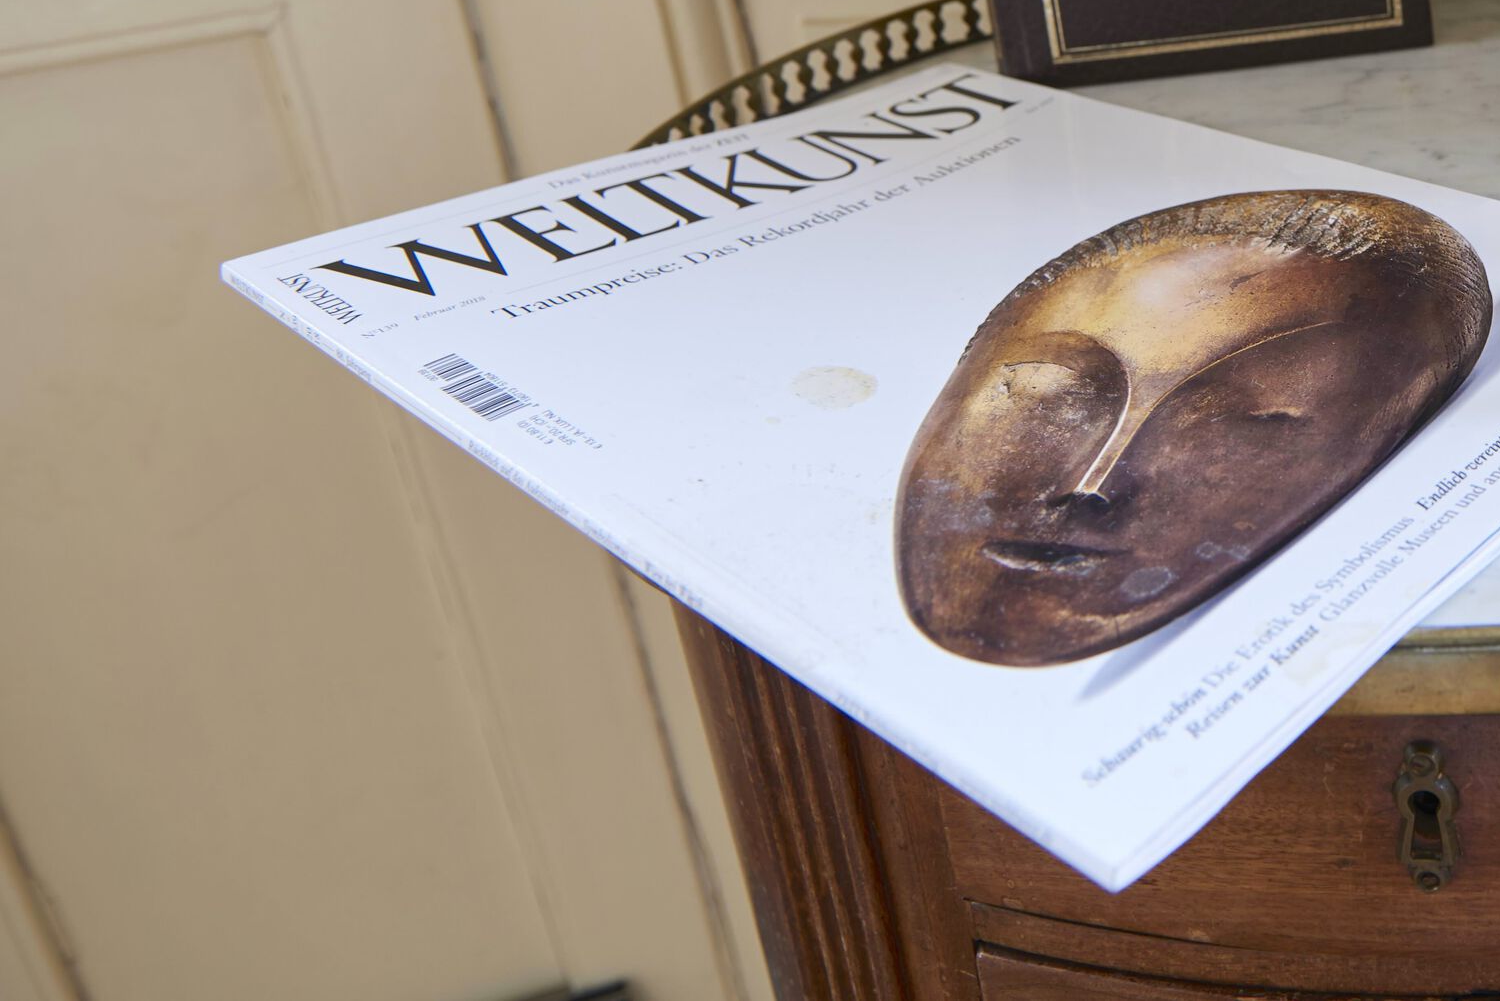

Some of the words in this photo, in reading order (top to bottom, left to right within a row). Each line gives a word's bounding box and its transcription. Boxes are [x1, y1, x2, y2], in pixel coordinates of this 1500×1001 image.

[310, 72, 1024, 297] WELTKUNST
[490, 261, 683, 318] Traumpreise:
[682, 242, 740, 265] Das
[739, 199, 873, 247] Rekordjahr
[874, 184, 913, 203] der
[912, 135, 1021, 187] Auktionen
[276, 273, 363, 326] WELTKUNST
[1201, 658, 1240, 689] Die
[1235, 614, 1293, 661] Erotik
[1288, 593, 1321, 618] des
[1315, 515, 1415, 593] Symbolismus
[1416, 470, 1468, 511] Endlich
[1242, 664, 1272, 690] zur
[1268, 625, 1320, 666] Kunst
[1318, 554, 1405, 622] Glanzvolle
[1397, 507, 1459, 557] Museen
[1455, 483, 1487, 509] und
